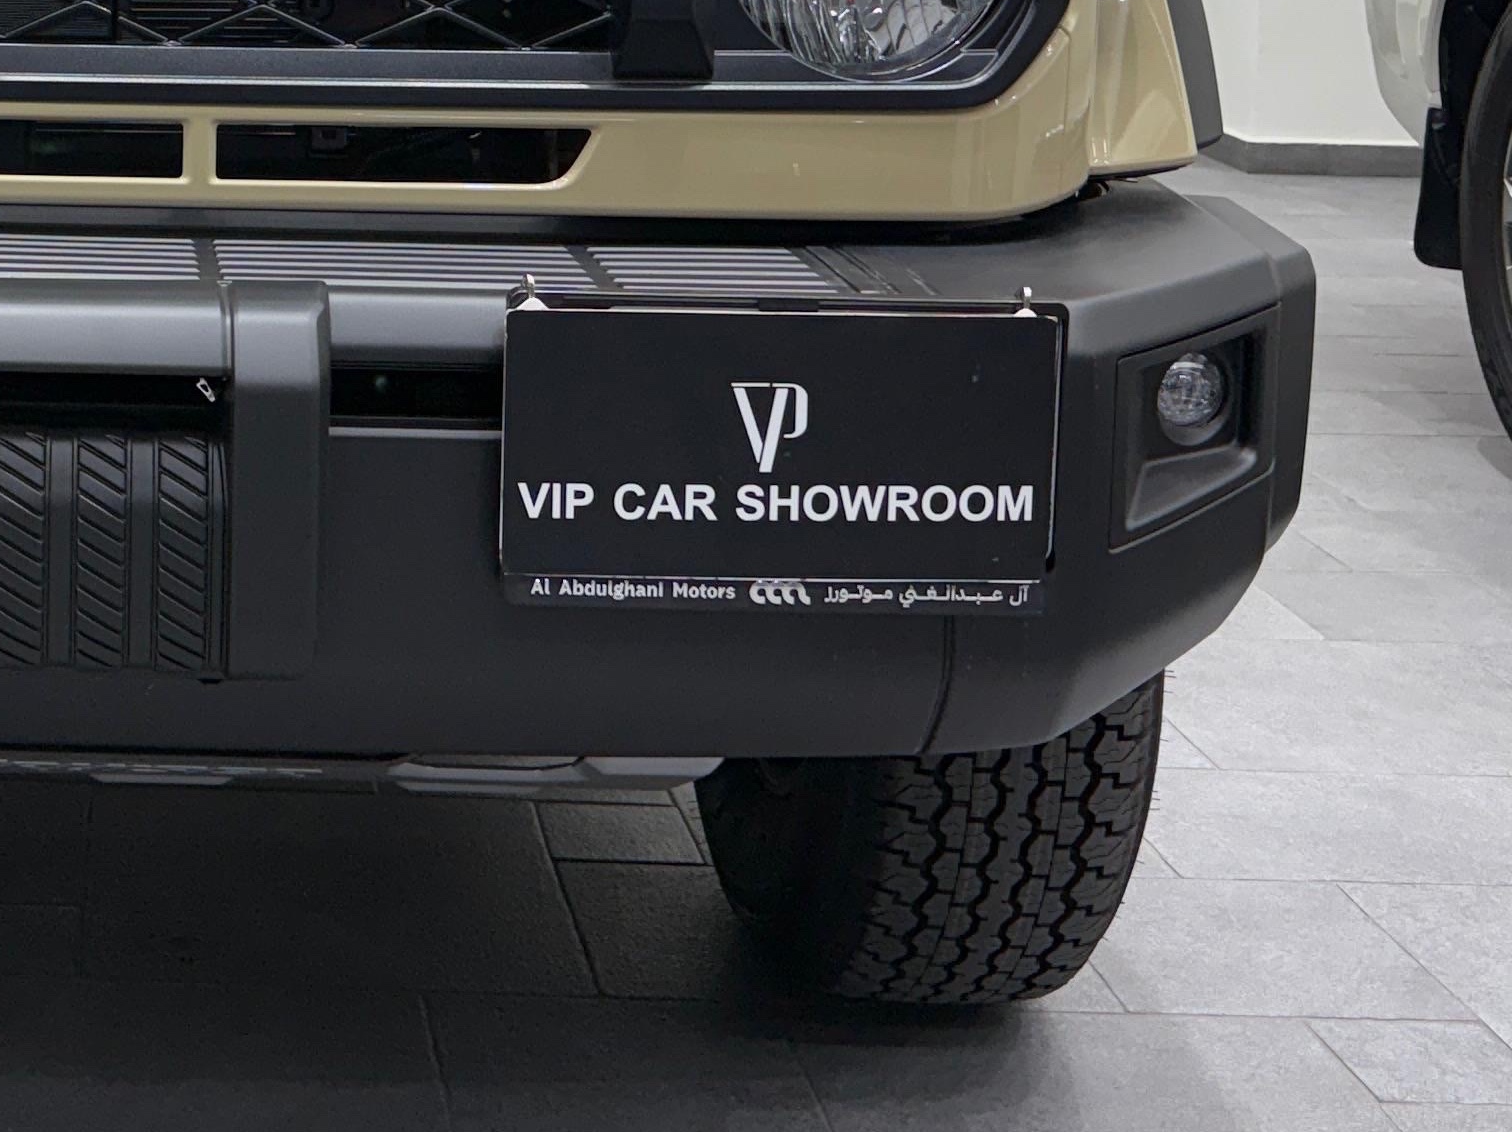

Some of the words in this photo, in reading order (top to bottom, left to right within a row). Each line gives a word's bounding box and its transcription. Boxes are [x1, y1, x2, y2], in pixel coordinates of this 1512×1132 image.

[518, 481, 595, 520] VIP
[613, 483, 718, 522] CAR
[735, 484, 1034, 523] SHOWROOM
[530, 578, 550, 596] Al
[558, 579, 664, 601] Abdulghani
[672, 581, 737, 600] Motors
[1009, 584, 1030, 607] آل
